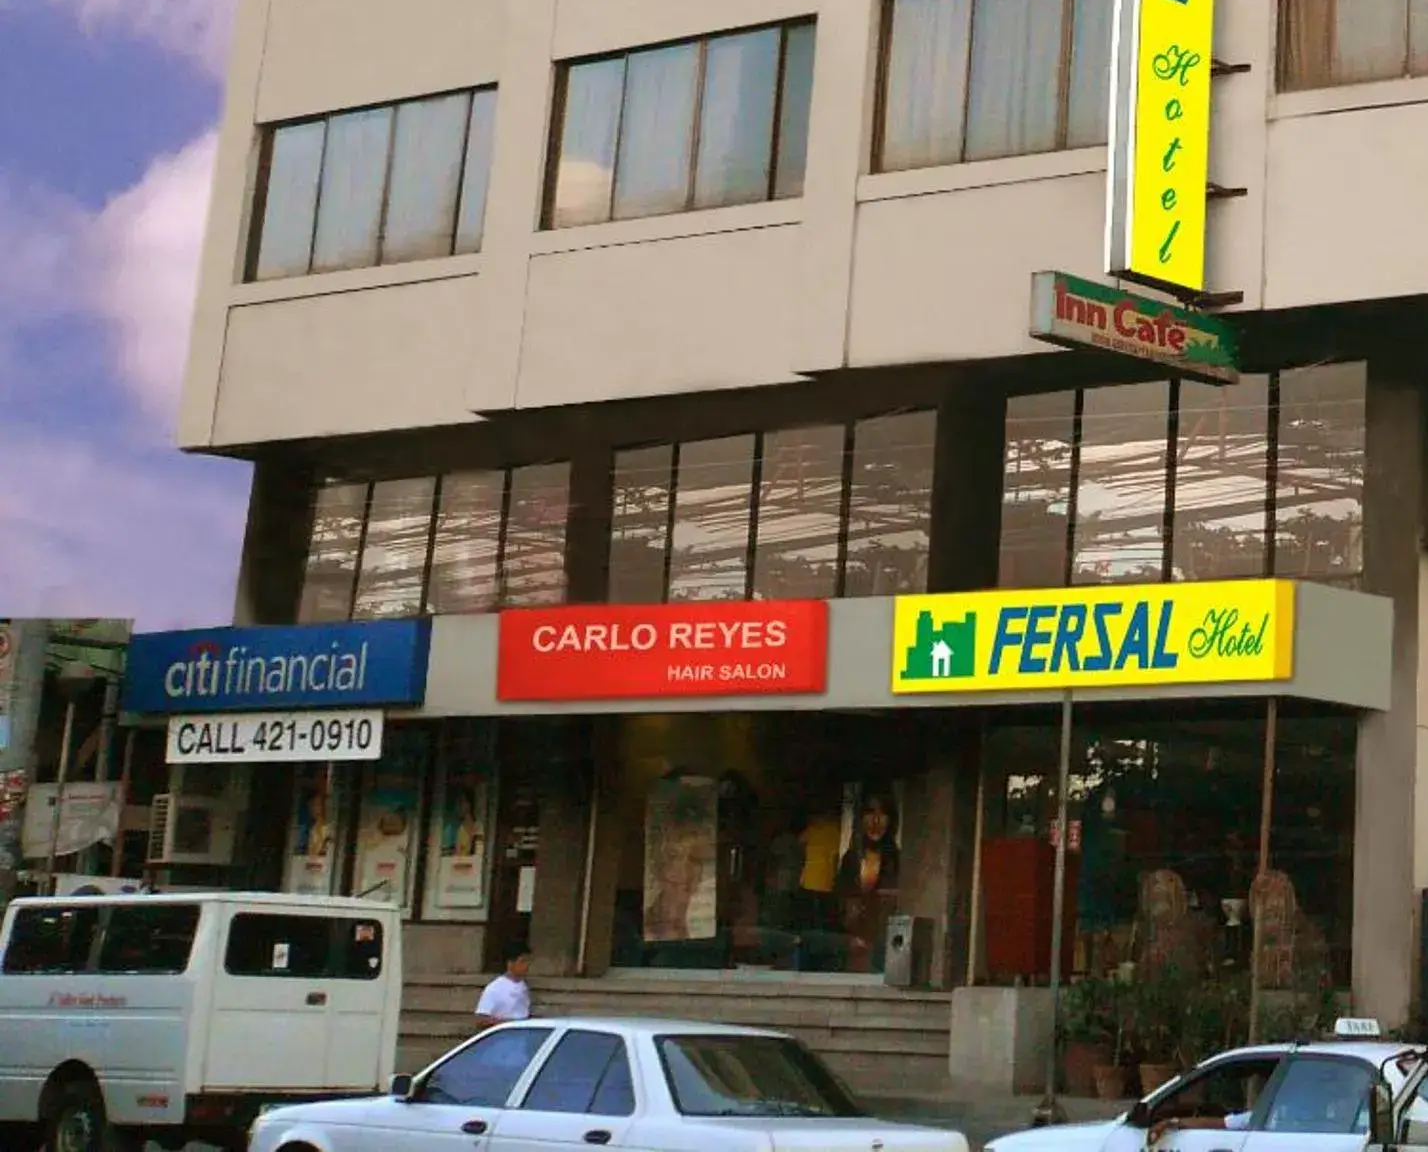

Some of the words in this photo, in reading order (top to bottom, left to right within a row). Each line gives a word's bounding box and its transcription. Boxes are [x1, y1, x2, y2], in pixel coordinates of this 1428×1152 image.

[1151, 44, 1201, 263] Hotel
[1054, 283, 1107, 330] Inn
[532, 622, 658, 653] CARLO
[669, 620, 788, 649] REYES
[987, 599, 1179, 676] FERSAL
[1187, 607, 1270, 659] Hotel
[667, 663, 714, 682] HAIR
[718, 662, 787, 682] SALON
[177, 721, 245, 755] CALL
[252, 718, 373, 752] 421-0910
